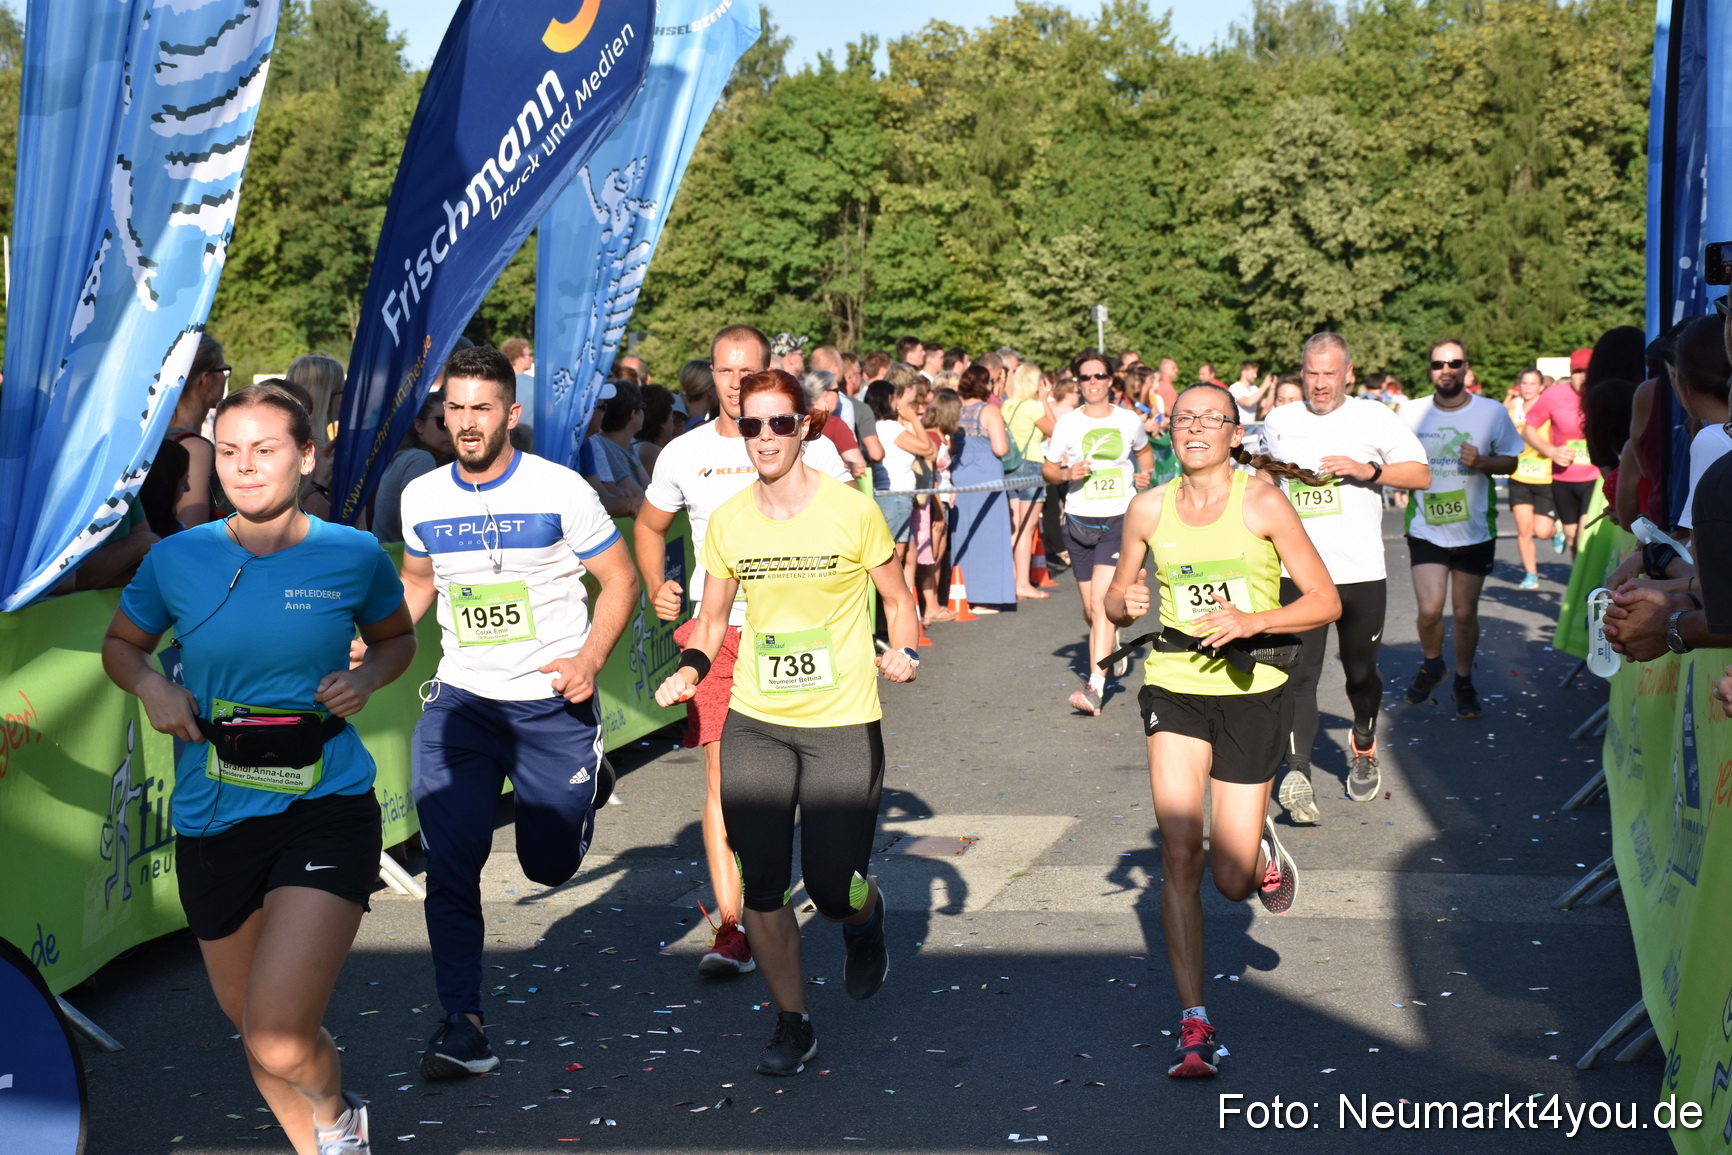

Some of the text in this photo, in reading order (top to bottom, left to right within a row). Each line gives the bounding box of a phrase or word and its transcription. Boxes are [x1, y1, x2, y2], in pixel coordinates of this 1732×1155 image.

[490, 23, 635, 221] Druck und Medien
[381, 69, 566, 347] Frischmann
[1092, 478, 1115, 491] 122
[1295, 489, 1333, 506] 1793
[1429, 501, 1463, 516] 1036
[459, 520, 525, 536] PLAST
[294, 589, 341, 600] PFLEIDERER
[1188, 582, 1232, 607] 331
[284, 602, 311, 610] Anna
[461, 603, 521, 629] 1955
[768, 652, 816, 678] 738
[798, 675, 822, 683] Bettina
[246, 773, 284, 786] Deutschland
[285, 779, 304, 787] GmbH
[253, 766, 301, 780] Anna-Lena
